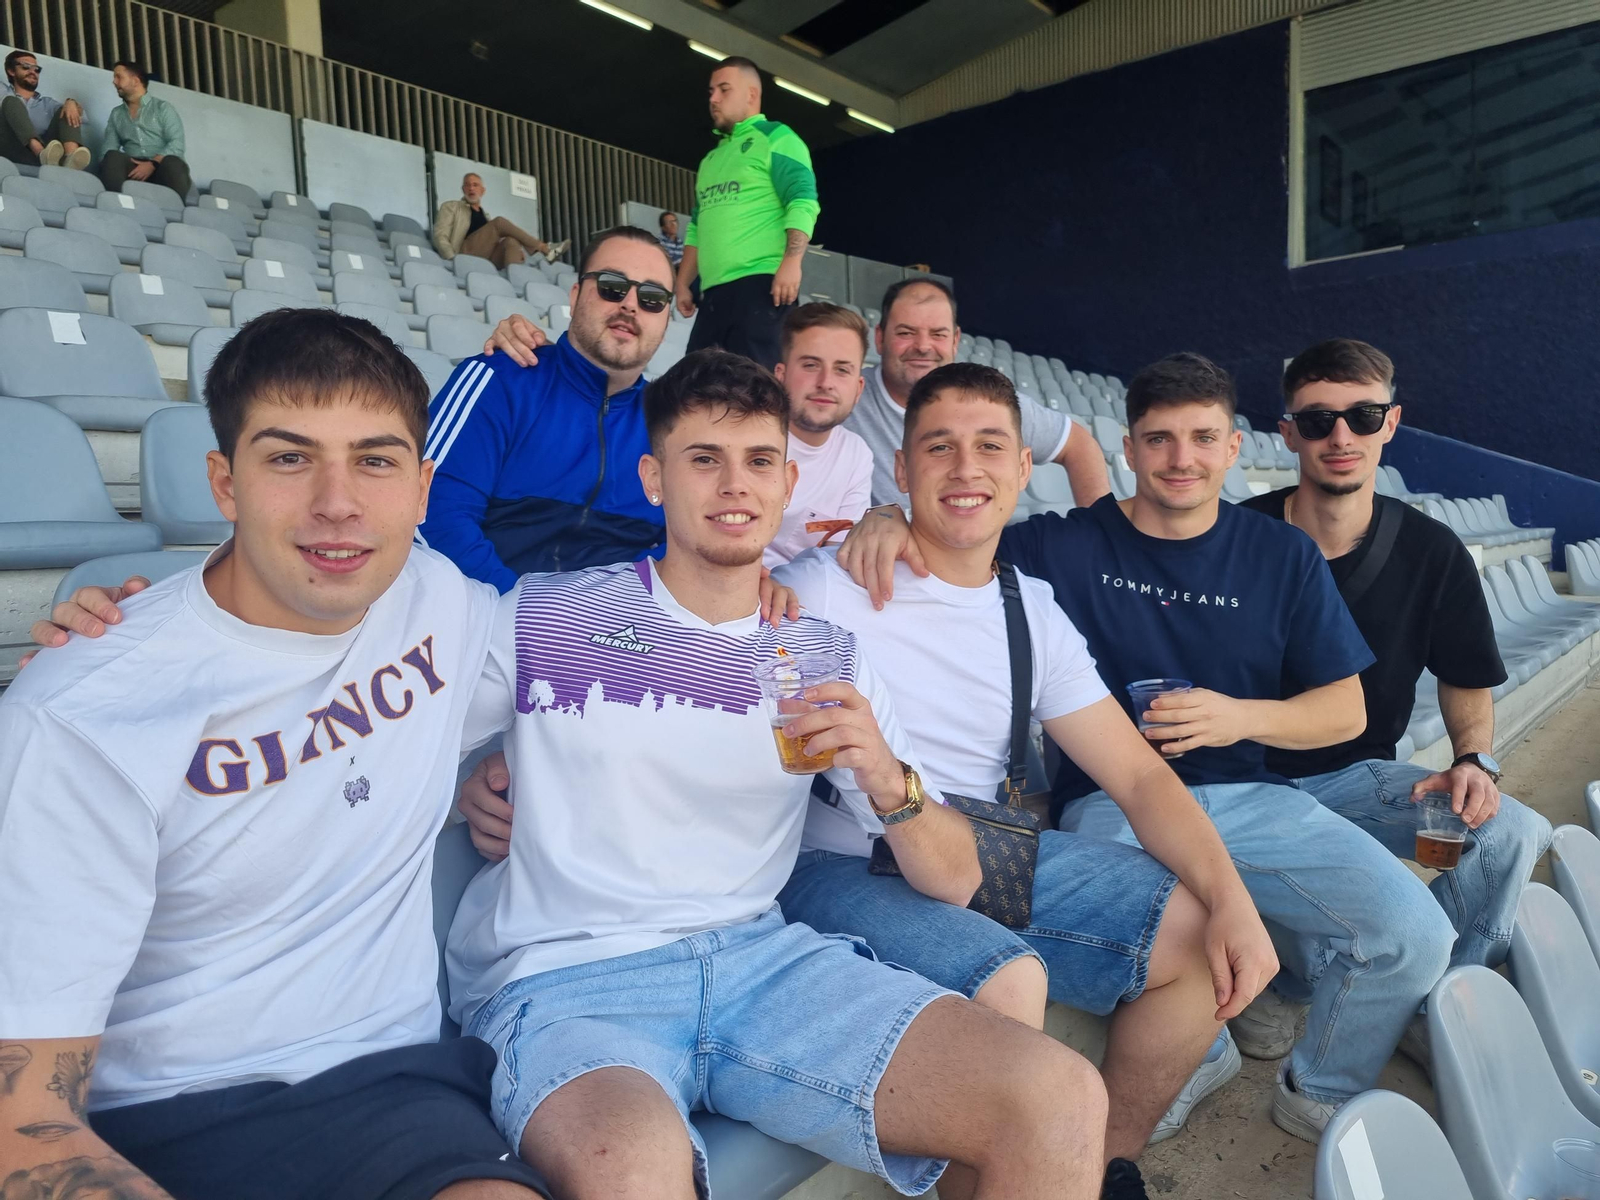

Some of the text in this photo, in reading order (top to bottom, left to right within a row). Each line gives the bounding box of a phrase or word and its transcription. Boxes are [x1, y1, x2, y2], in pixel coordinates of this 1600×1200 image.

[1101, 573, 1240, 608] TOMMY JEANS
[589, 634, 655, 654] MERCURY
